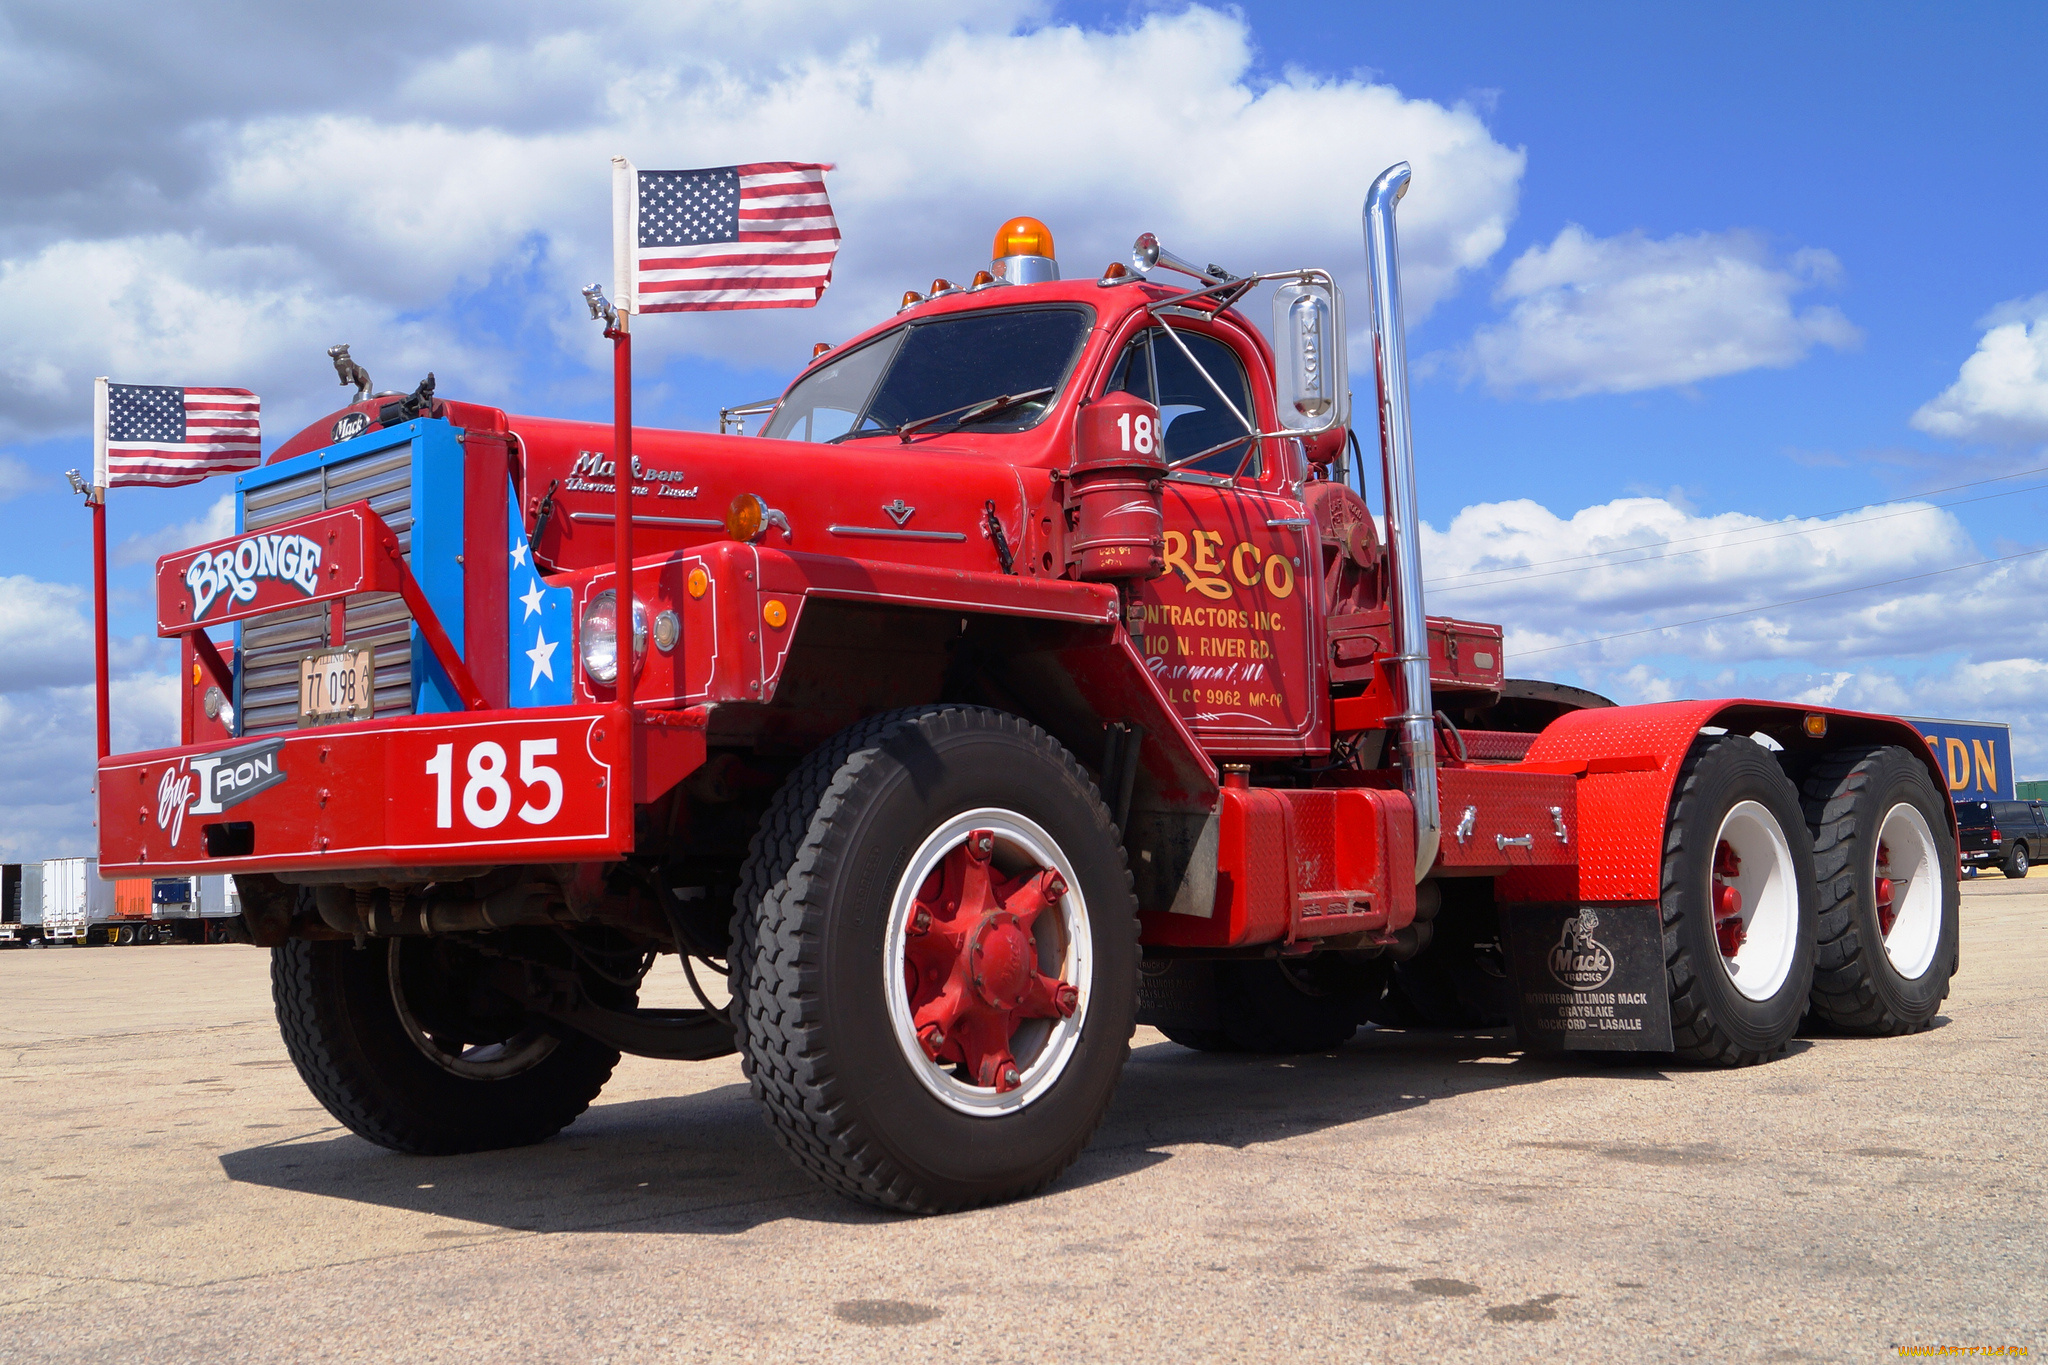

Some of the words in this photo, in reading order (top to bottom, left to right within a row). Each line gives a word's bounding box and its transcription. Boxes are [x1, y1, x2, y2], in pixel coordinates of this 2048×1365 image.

[1301, 317, 1319, 391] MACK
[333, 414, 363, 441] Mack
[570, 450, 643, 479] Mak
[186, 534, 322, 622] BRONGE
[319, 653, 352, 666] ILLINOIS
[1200, 637, 1246, 658] RIVER
[1250, 639, 1274, 660] RD.
[307, 672, 322, 709] 77
[329, 668, 356, 706] 098
[1206, 689, 1241, 706] 9962
[1924, 735, 1998, 794] DN
[425, 738, 563, 829] 185
[1554, 948, 1610, 972] Mack
[1563, 972, 1603, 983] TRUCKS
[1525, 993, 1574, 1005] NORTHERN
[1574, 993, 1616, 1005] ILLINOIS
[1617, 993, 1648, 1005] MACK
[1558, 1006, 1615, 1018] GRAYSLAKE
[1538, 1019, 1587, 1031] ROCKFORD
[1600, 1019, 1642, 1031] LASALLE
